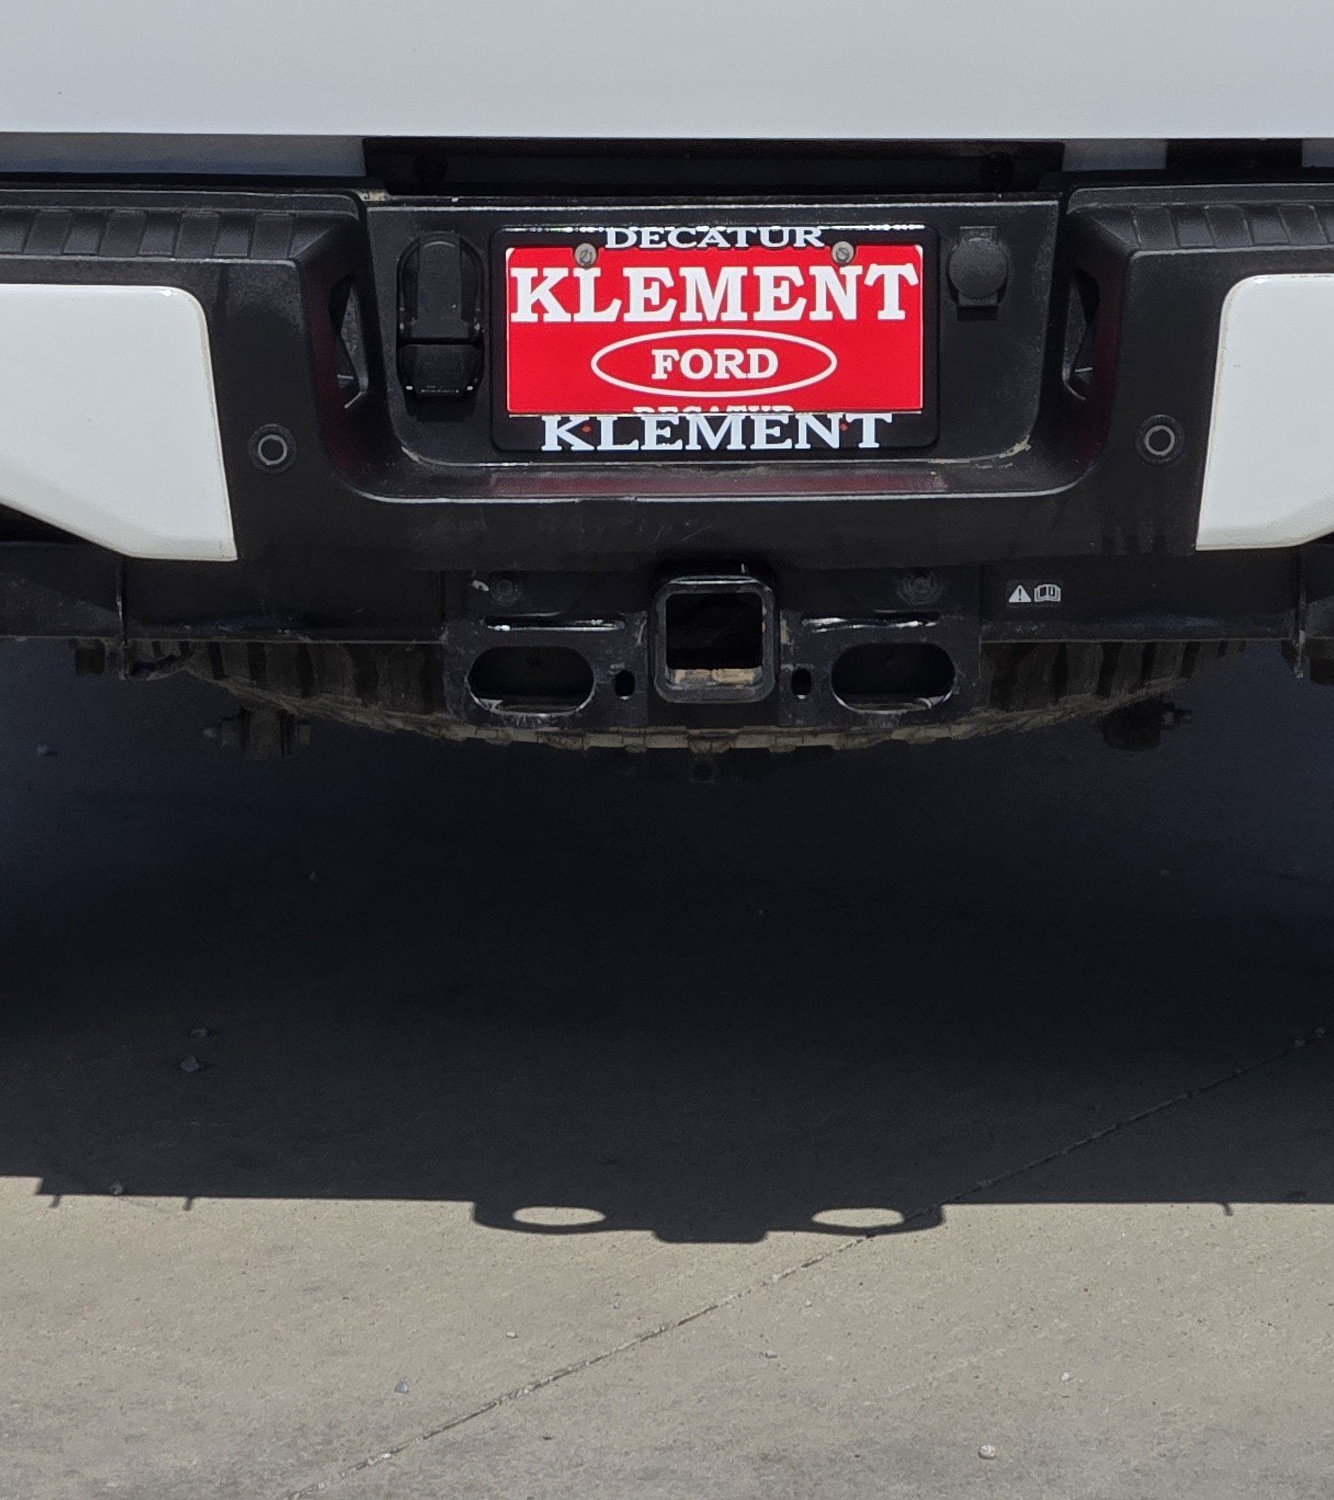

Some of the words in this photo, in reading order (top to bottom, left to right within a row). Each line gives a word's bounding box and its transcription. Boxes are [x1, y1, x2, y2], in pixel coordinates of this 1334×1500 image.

[605, 227, 825, 249] DECATUR
[510, 264, 919, 323] KLEMENT
[651, 348, 779, 380] FORD
[541, 413, 892, 451] KLEMENT
